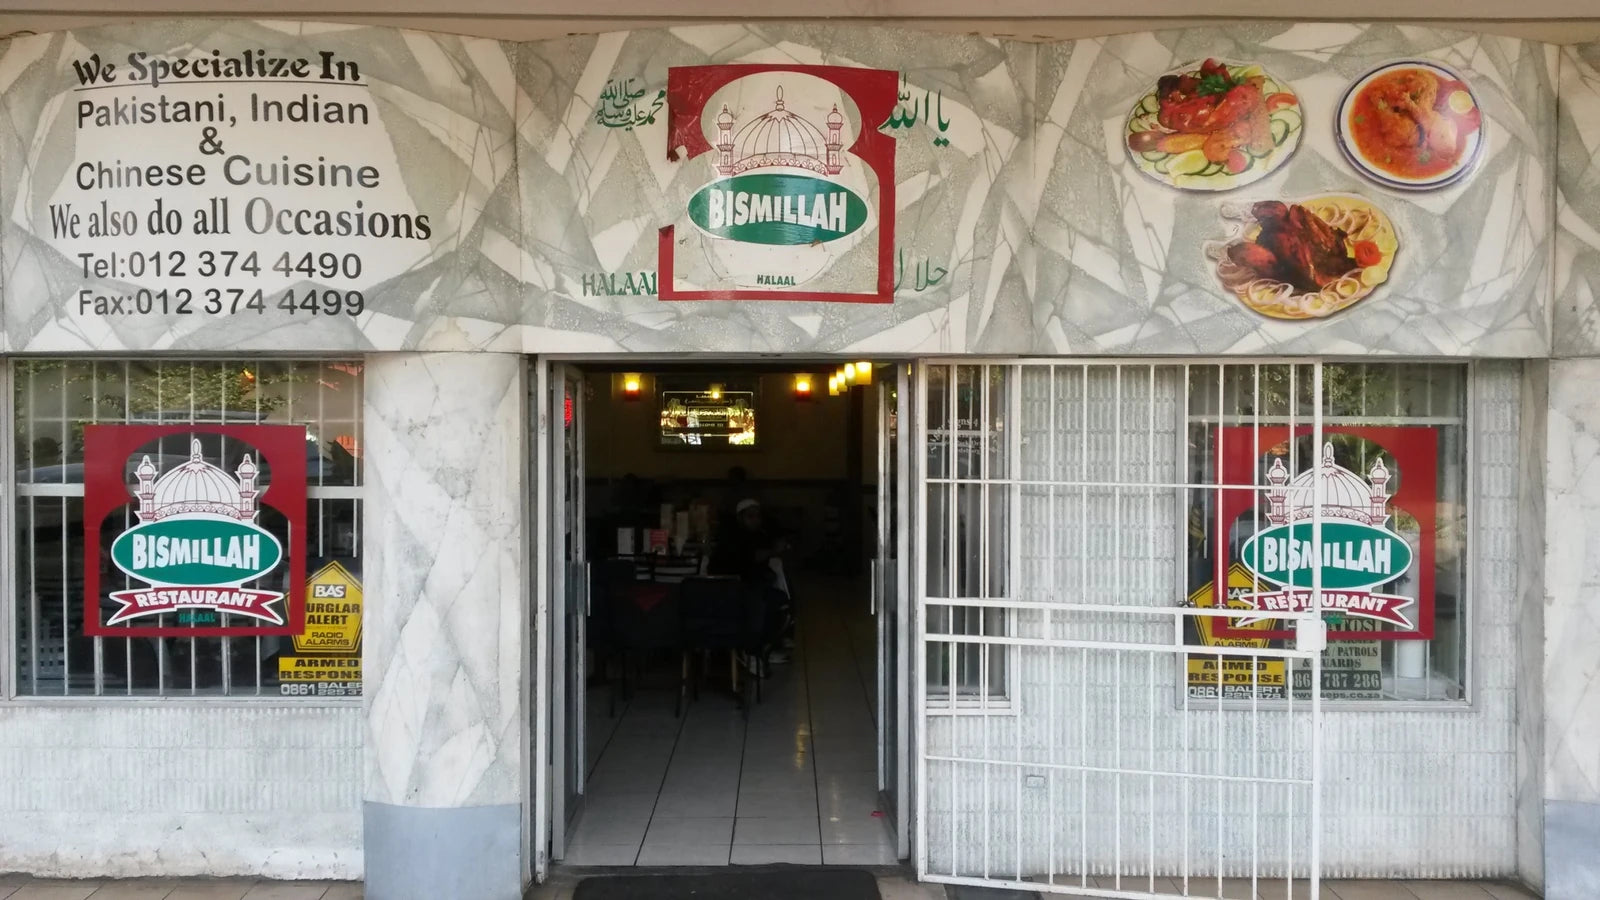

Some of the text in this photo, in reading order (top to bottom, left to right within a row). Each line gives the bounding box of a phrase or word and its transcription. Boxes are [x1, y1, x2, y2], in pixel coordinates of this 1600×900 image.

[73, 50, 360, 87] We Specialize In
[78, 93, 369, 129] Pakistani, Indian
[199, 126, 225, 155] &
[76, 155, 380, 190] Chinese Cuisine
[49, 197, 432, 241] We also do all Occasions
[709, 188, 847, 233] BISMILLAH
[78, 251, 362, 279] Tel:012 374 4490
[757, 274, 797, 286] HALAAL
[79, 288, 365, 317] Fax:012 374 4499
[132, 534, 260, 570] BISMILLAH
[1263, 537, 1391, 574] BISMILLAH
[134, 590, 257, 608] RESTAURANT
[315, 585, 345, 597] BAS
[306, 603, 360, 614] URGLAR
[307, 615, 348, 624] ALERT
[1337, 647, 1378, 656] PATROLS
[295, 659, 359, 667] ARMED
[1321, 658, 1362, 668] UARDS
[280, 671, 362, 679] RESPONS
[1353, 673, 1380, 688] 286
[280, 683, 315, 695] 0861
